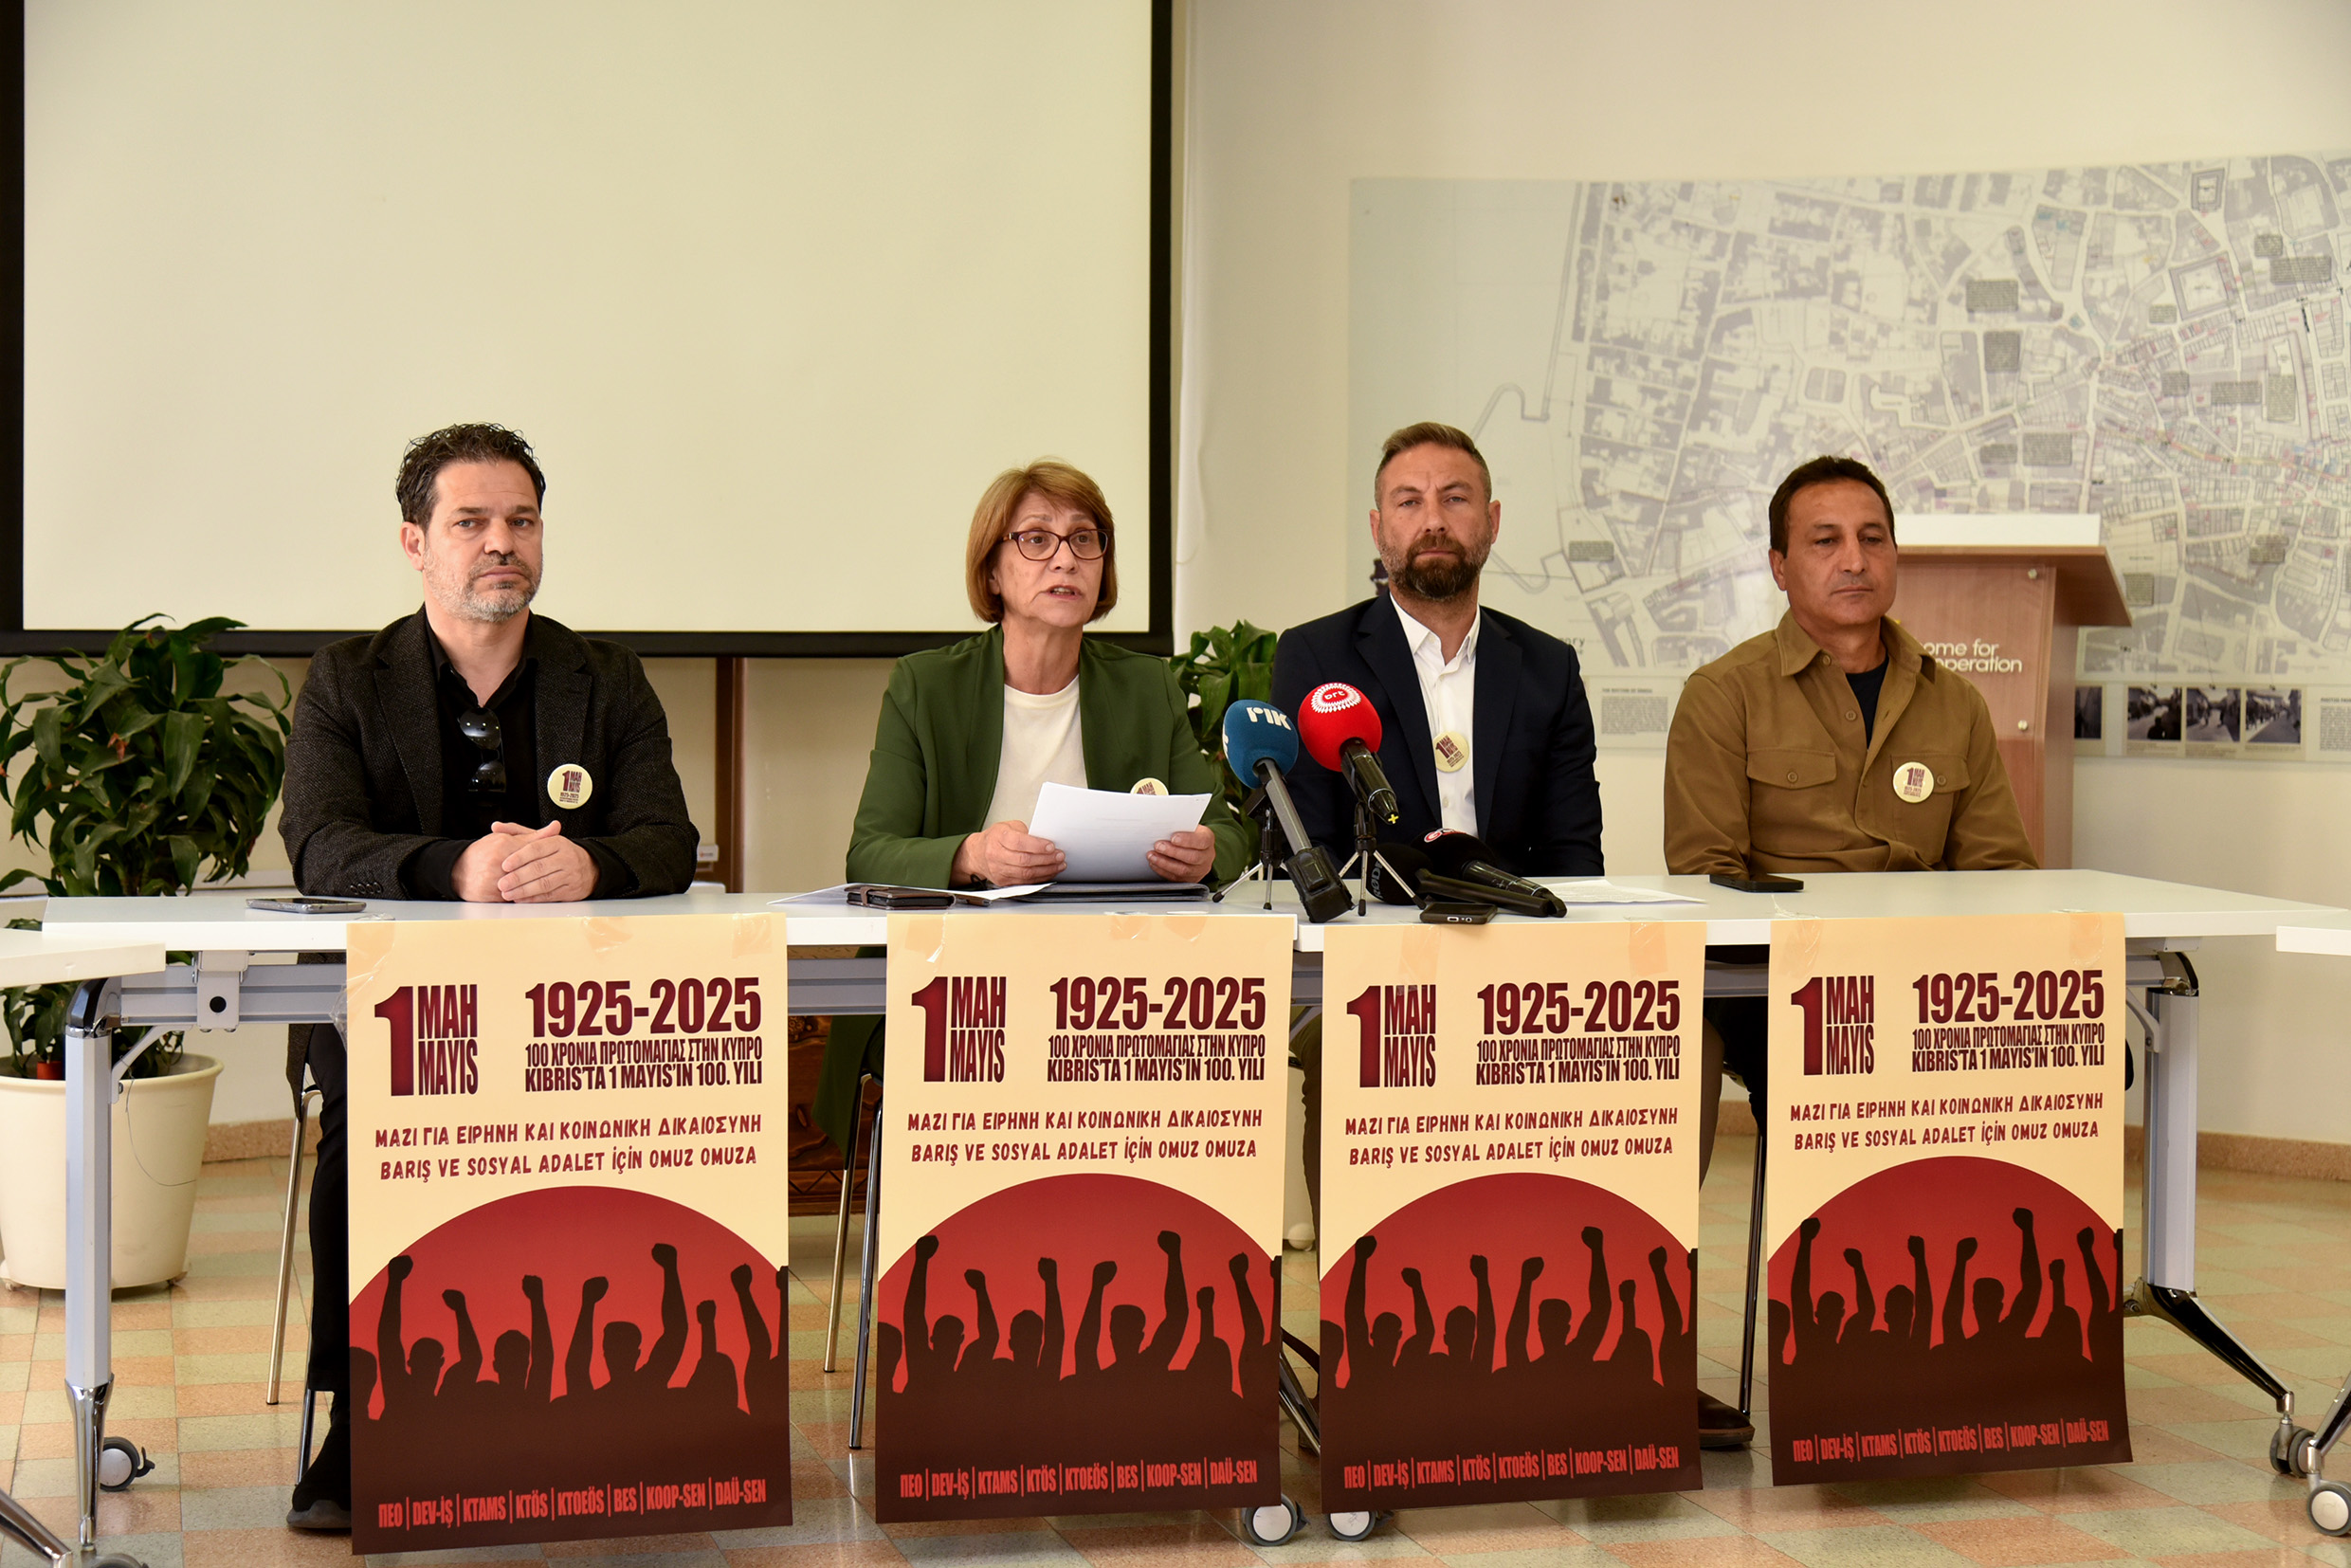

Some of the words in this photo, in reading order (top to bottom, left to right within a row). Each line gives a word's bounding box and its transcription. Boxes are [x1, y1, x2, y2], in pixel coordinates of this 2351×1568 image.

[1973, 638, 1999, 657] for
[1324, 690, 1346, 700] brt
[562, 770, 570, 792] 1
[1906, 767, 1914, 785] 1
[525, 977, 761, 1037] 1925-2025
[1050, 976, 1266, 1030] 1925-2025
[1478, 980, 1680, 1035] 1925-2025
[1913, 970, 2104, 1024] 1925-2025
[374, 986, 413, 1096] 1
[912, 976, 948, 1082] 1
[1347, 986, 1380, 1087] 1
[1791, 977, 1823, 1075] 1
[1913, 1029, 1931, 1049] 100
[525, 1043, 548, 1067] 100
[950, 1029, 1005, 1083] MAYIS
[1048, 1035, 1069, 1057] 100
[1384, 1035, 1435, 1087] MAYIS
[1477, 1040, 1497, 1062] 100
[1827, 1025, 1874, 1075] MAYIS
[1912, 1048, 1977, 1072] KIBRIS'TA
[1980, 1048, 1986, 1069] 1
[1990, 1047, 2048, 1069] MAYIS'IN
[2050, 1046, 2078, 1067] 100.
[2081, 1045, 2104, 1066] YILI
[418, 1039, 478, 1095] MAYIS
[525, 1066, 606, 1092] KIBRIS'TA
[609, 1066, 616, 1088] 1
[621, 1063, 692, 1088] MAYIS'IN
[697, 1062, 730, 1085] 100.
[734, 1061, 761, 1085] YILI
[1048, 1059, 1121, 1082] KIBRIS'TA
[1124, 1059, 1131, 1081] 1
[1135, 1058, 1201, 1081] MAYIS'IN
[1204, 1058, 1234, 1081] 100.
[1238, 1058, 1265, 1080] YILI
[1476, 1061, 1545, 1085] KIBRIS'TA
[1548, 1062, 1555, 1083] 1
[1558, 1060, 1620, 1083] MAYIS'IN
[1623, 1059, 1651, 1081] 100.
[1655, 1058, 1679, 1080] YILI
[912, 1144, 957, 1166] BARIŞ
[965, 1143, 985, 1161] VE
[992, 1143, 1050, 1160] SOSYAL
[1057, 1141, 1118, 1159] ADALET
[1124, 1136, 1152, 1162] İÇİN
[1159, 1140, 1198, 1158] OMUZ
[1206, 1140, 1256, 1158] OMUZA
[1350, 1147, 1394, 1167] BARIŞ
[1400, 1146, 1418, 1163] VE
[1426, 1144, 1480, 1162] SOSYAL
[1486, 1141, 1542, 1160] ADALET
[1549, 1136, 1575, 1161] İÇİN
[1581, 1139, 1618, 1157] OMUZ
[1625, 1138, 1672, 1155] OMUZA
[1795, 1133, 1835, 1153] BARIŞ
[1842, 1131, 1859, 1148] VE
[1866, 1129, 1916, 1146] SOSYAL
[1923, 1126, 1976, 1144] ADALET
[1981, 1121, 2005, 1145] İÇİN
[2012, 1123, 2047, 1140] OMUZ
[2053, 1121, 2098, 1139] OMUZA
[381, 1160, 430, 1182] BARIŞ
[439, 1158, 459, 1176] VE
[467, 1156, 531, 1176] SOSYAL
[539, 1153, 605, 1173] ADALET
[612, 1145, 642, 1173] İÇİN
[650, 1149, 693, 1168] OMUZ
[702, 1146, 756, 1165] OMUZA
[1821, 1433, 1854, 1462] DEV-İŞ
[1862, 1434, 1897, 1457] KTAMS
[1904, 1429, 1931, 1454] KTÖS
[1939, 1426, 1977, 1451] KTOEÖS
[1984, 1427, 2004, 1449] BES
[2011, 1424, 2060, 1447] KOOP-SEN
[2067, 1418, 2108, 1443] DAÜ-SEN
[932, 1468, 969, 1500] DEV-İŞ
[978, 1469, 1018, 1494] KTAMS
[1027, 1465, 1056, 1492] KTÖS
[1066, 1463, 1108, 1490] KTOEÖS
[1117, 1465, 1139, 1488] BES
[1147, 1463, 1202, 1486] KOOP-SEN
[1211, 1458, 1257, 1485] DAÜ-SEN
[1374, 1460, 1409, 1489] DEV-İŞ
[1417, 1460, 1454, 1484] KTAMS
[1463, 1454, 1491, 1481] KTÖS
[1499, 1451, 1540, 1479] KTOEÖS
[1547, 1453, 1568, 1475] BES
[1576, 1449, 1627, 1474] KOOP-SEN
[1634, 1445, 1679, 1470] DAÜ-SEN
[413, 1496, 453, 1528] DEV-İŞ
[464, 1496, 506, 1522] KTAMS
[516, 1490, 548, 1519] KTÖS
[558, 1486, 605, 1516] KTOEÖS
[614, 1487, 637, 1512] BES
[647, 1483, 706, 1509] KOOP-SEN
[715, 1477, 766, 1505] DAÜ-SEN
